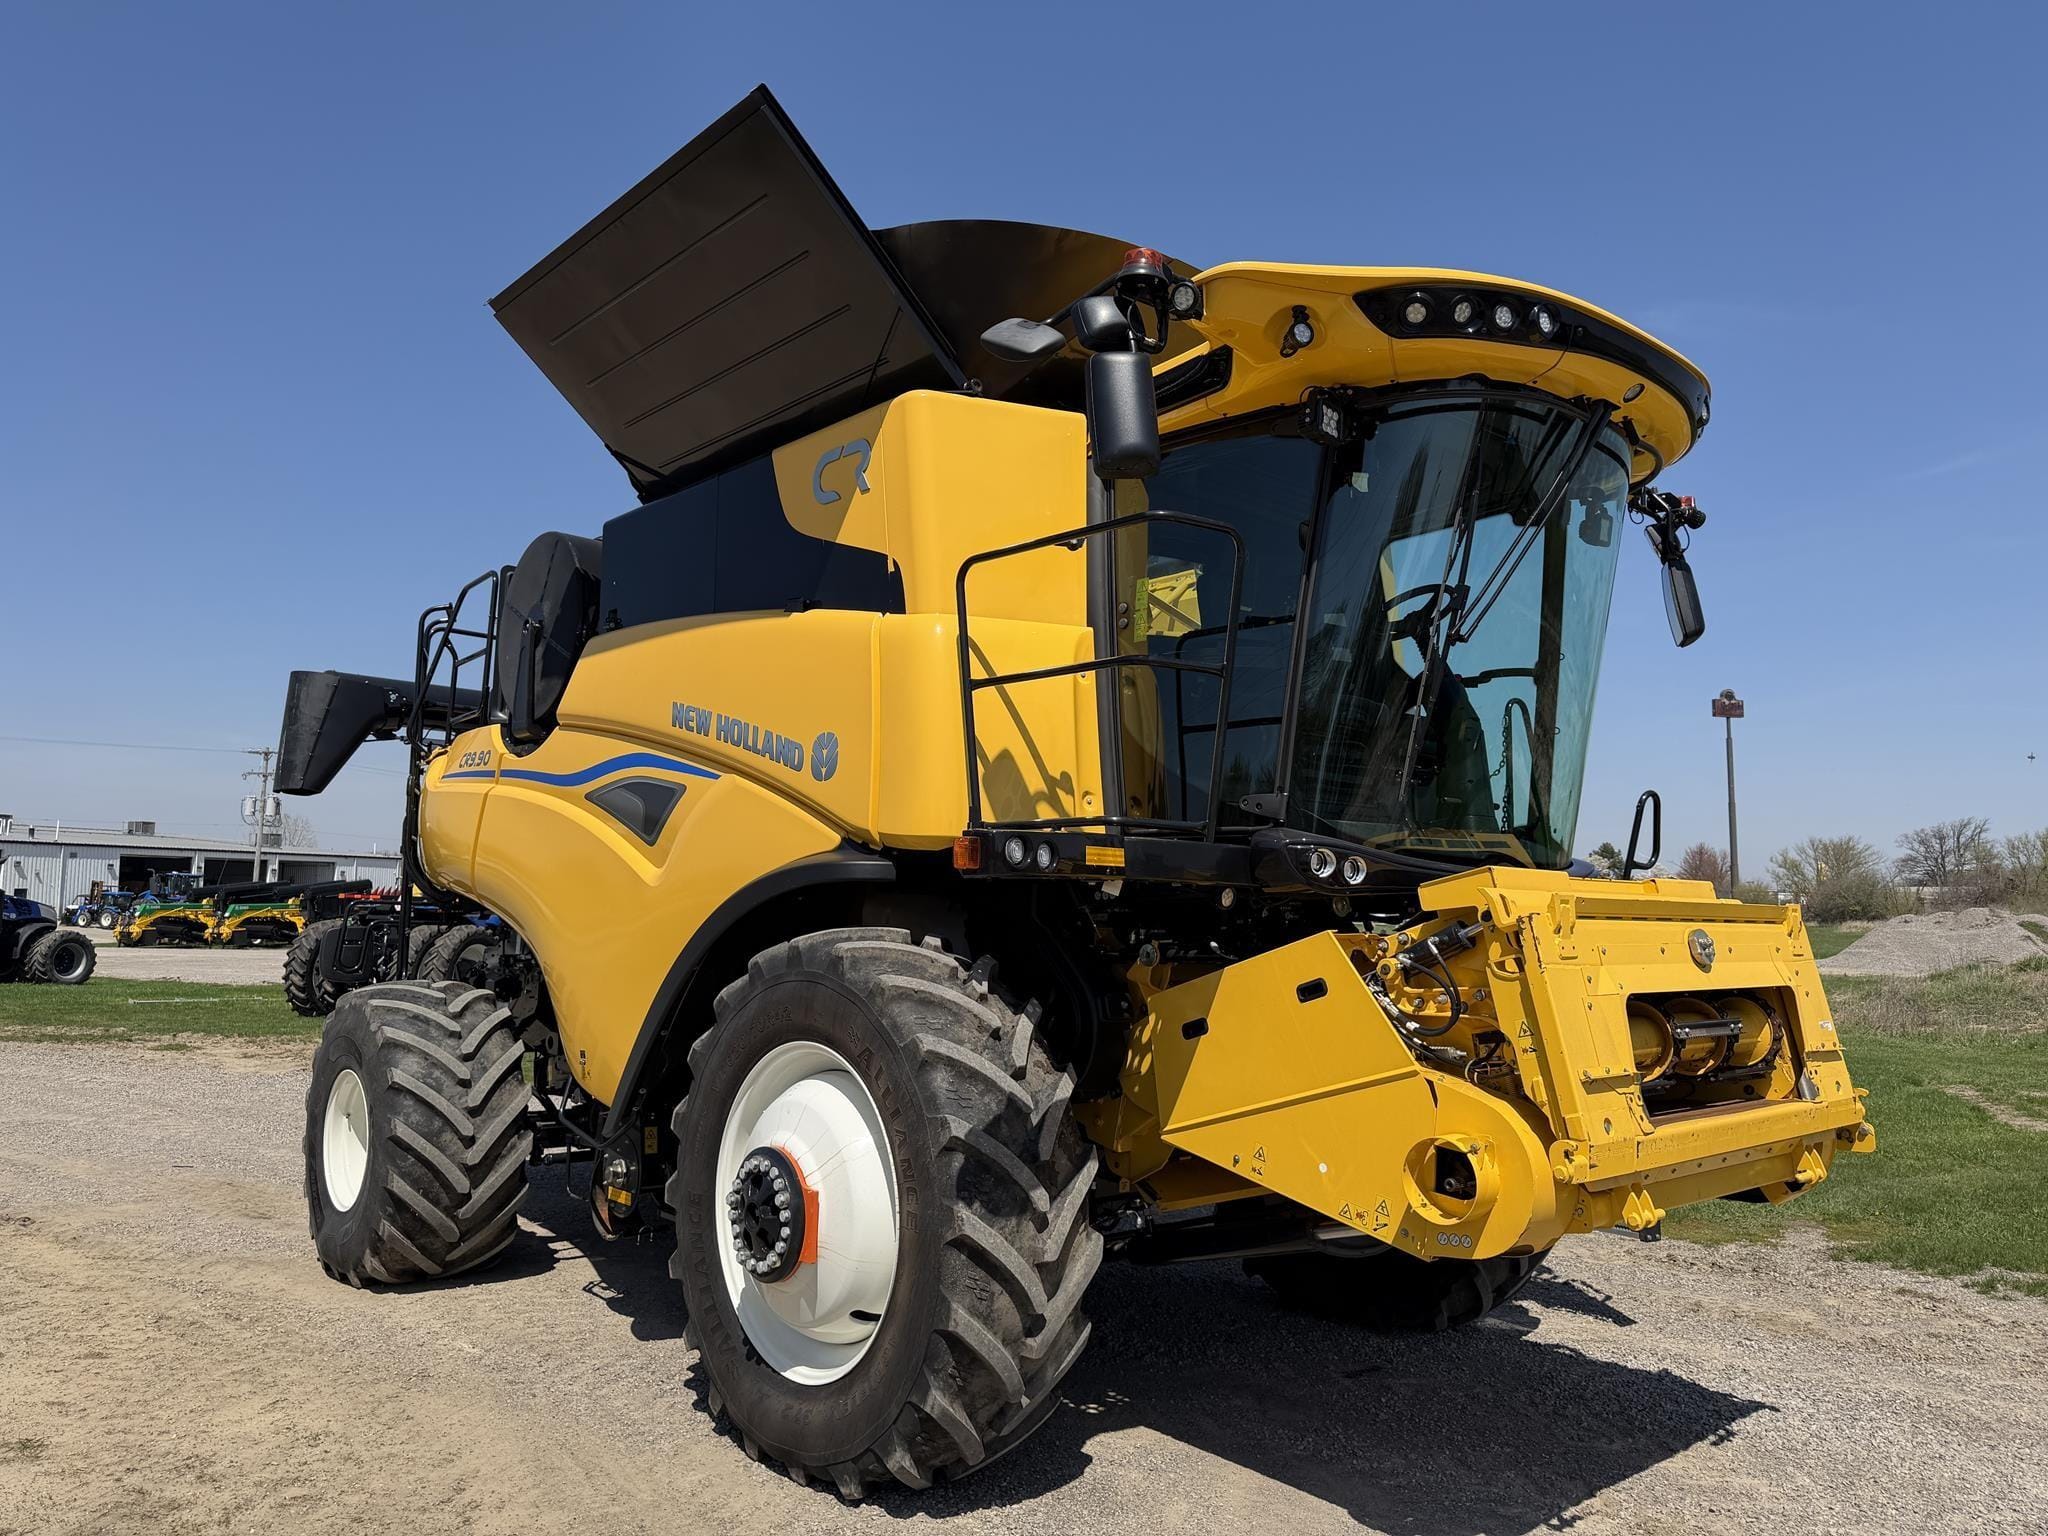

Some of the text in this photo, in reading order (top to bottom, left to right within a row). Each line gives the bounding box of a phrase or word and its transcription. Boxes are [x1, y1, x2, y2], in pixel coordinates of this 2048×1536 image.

[813, 438, 871, 505] CR
[459, 750, 491, 768] CR9.90
[672, 701, 804, 772] NEW HOLLAND
[857, 1046, 920, 1233] ALLIANCE
[688, 1192, 738, 1355] ALLIANCE
